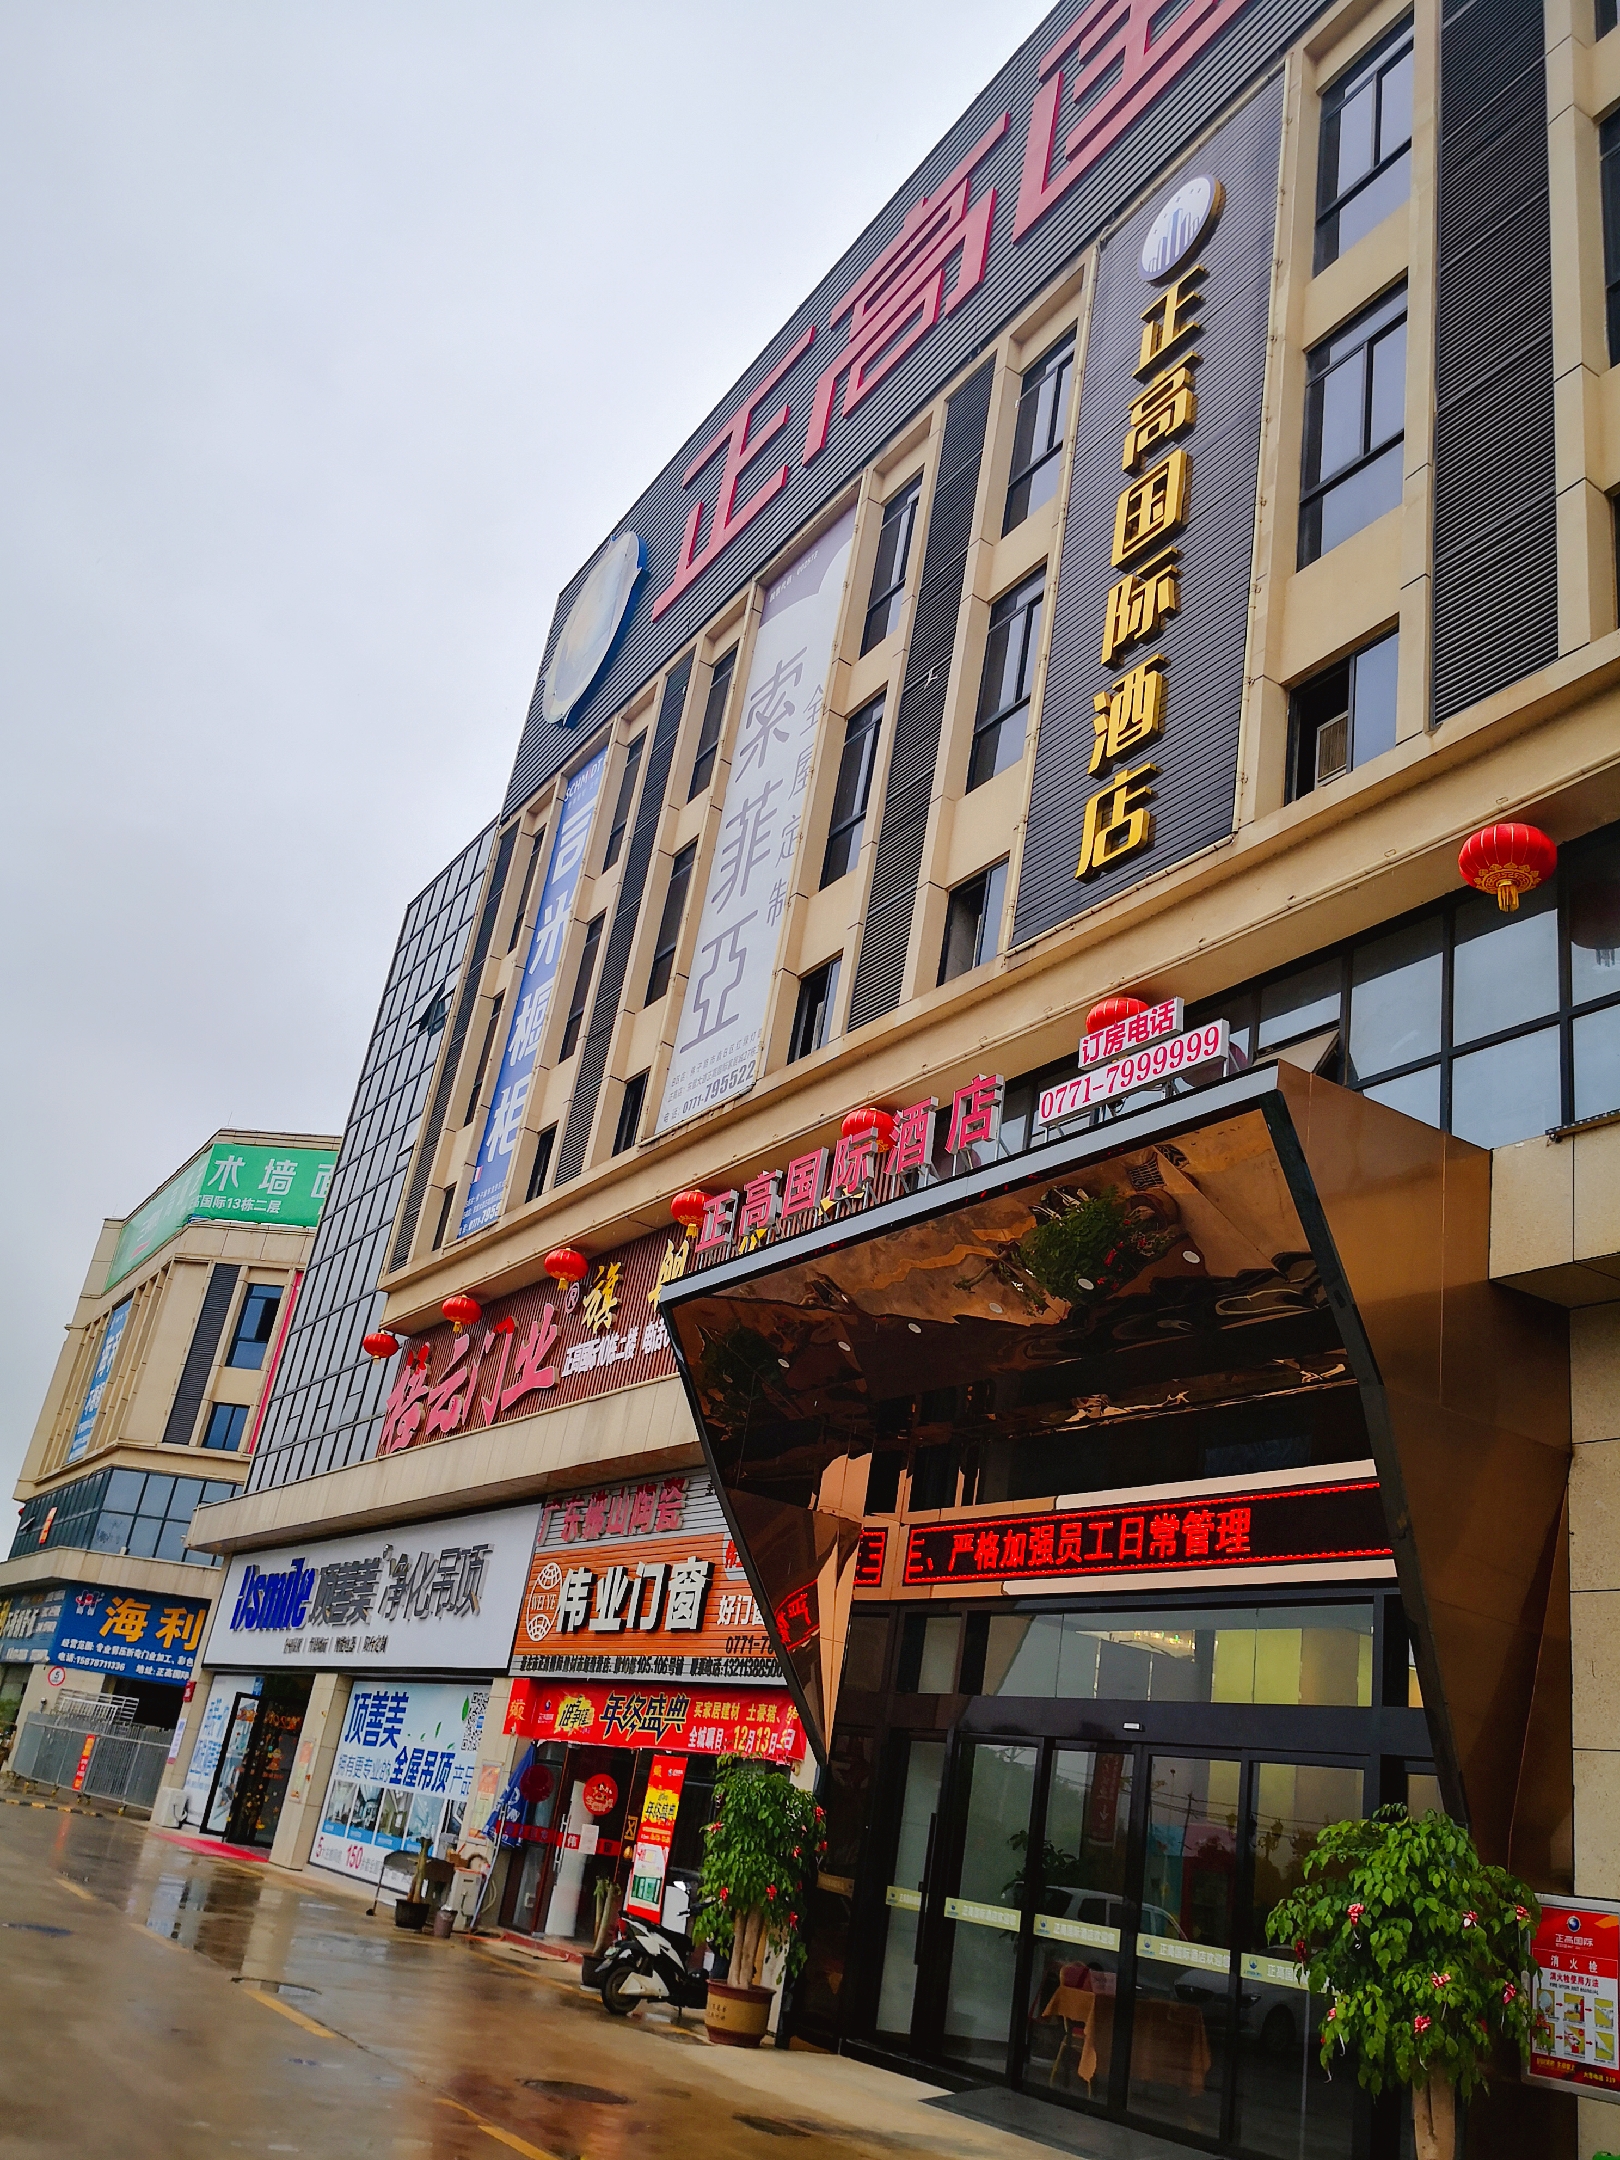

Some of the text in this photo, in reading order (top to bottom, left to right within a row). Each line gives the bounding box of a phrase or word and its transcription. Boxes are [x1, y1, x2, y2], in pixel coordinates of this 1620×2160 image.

[1076, 264, 1208, 883] 正高国际酒店
[486, 795, 599, 1163] 司米橱柜
[1082, 1000, 1175, 1064] 订房电话
[1040, 1026, 1221, 1120] 0771-7999999
[696, 1074, 1003, 1252] 正高国际酒店
[538, 1477, 691, 1545] 广东佛山陶瓷
[907, 1507, 1253, 1576] 三、严格加强员工日常管理
[307, 1557, 383, 1626] 顶善美
[377, 1544, 495, 1621] 净化吊顶
[556, 1557, 713, 1633] 伟业门窗
[99, 1596, 208, 1650] 海利
[344, 1691, 409, 1749] 顶善美
[599, 1690, 691, 1745] 年终盛典
[1555, 1933, 1594, 1947] 正高国际
